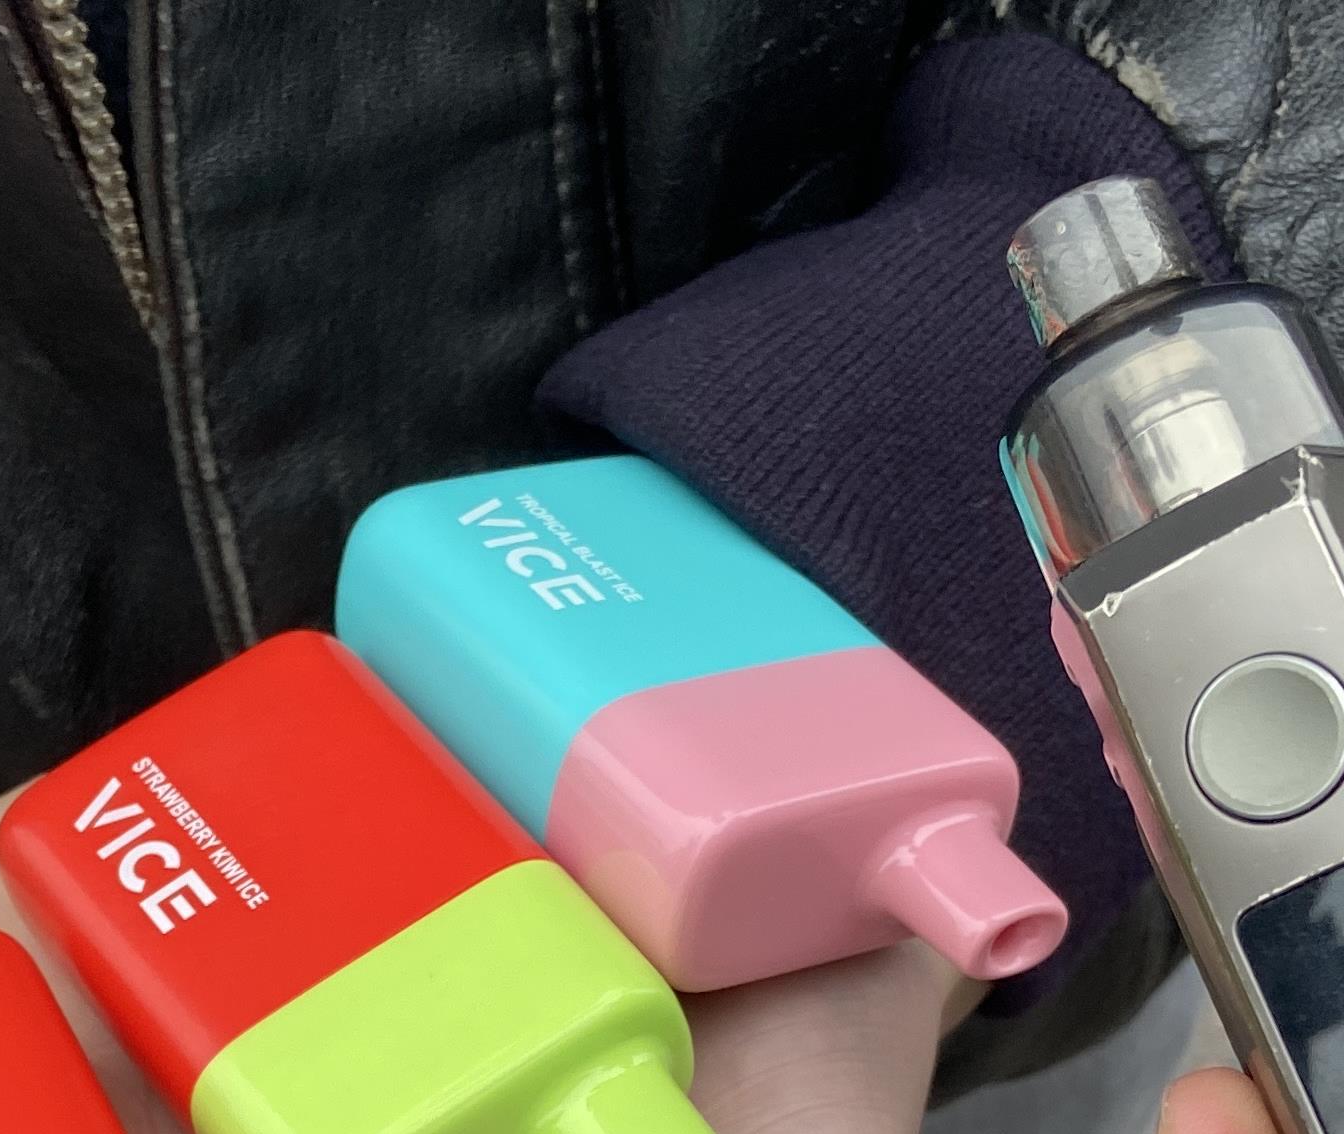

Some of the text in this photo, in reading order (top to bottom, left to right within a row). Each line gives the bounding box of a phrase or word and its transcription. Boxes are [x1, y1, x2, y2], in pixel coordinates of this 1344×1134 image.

[457, 497, 606, 611] VICE
[515, 493, 645, 603] TROPICAL BLAST ICE
[73, 776, 218, 935] VICE
[131, 756, 270, 910] STRAWBERRY KIWI ICE
